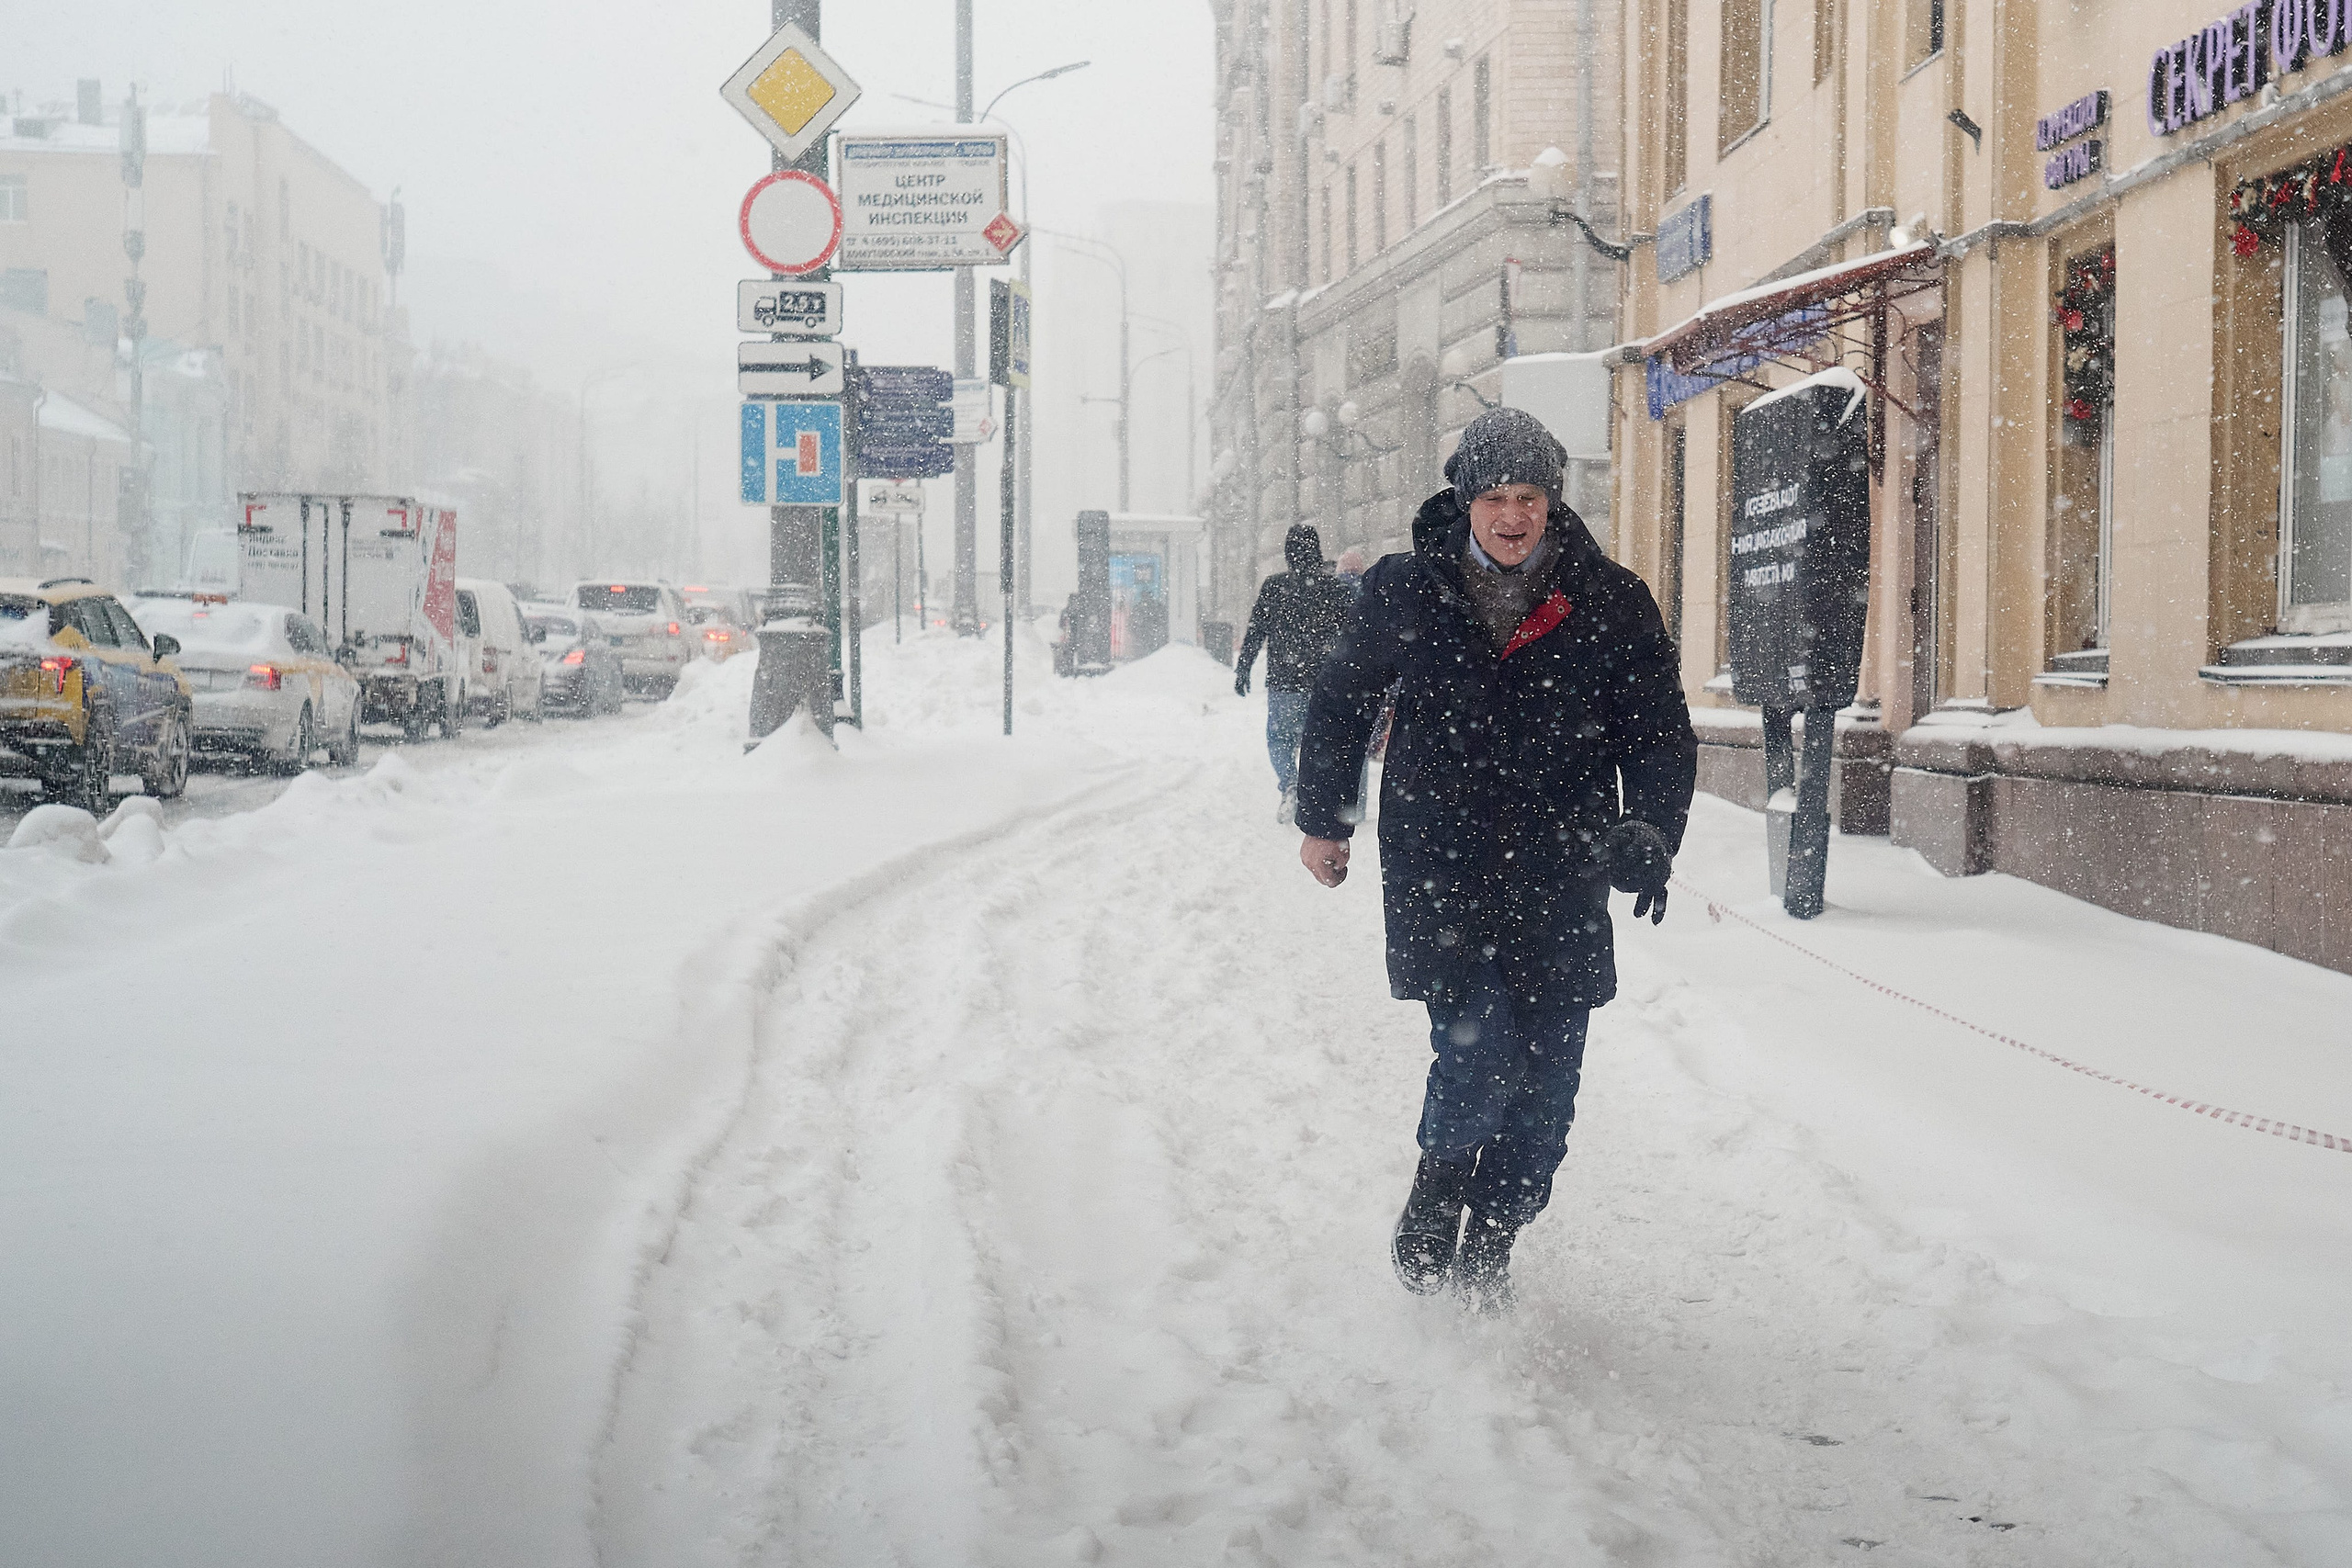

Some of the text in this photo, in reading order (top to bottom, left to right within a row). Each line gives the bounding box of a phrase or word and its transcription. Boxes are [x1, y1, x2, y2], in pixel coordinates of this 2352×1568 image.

[2146, 0, 2352, 137] СЕКРЕТ ФО
[895, 175, 946, 189] ЦЕНТР
[858, 188, 984, 209] МЕДИЦИНСКОЙ
[868, 211, 968, 226] ИНСПЕКЦИИ
